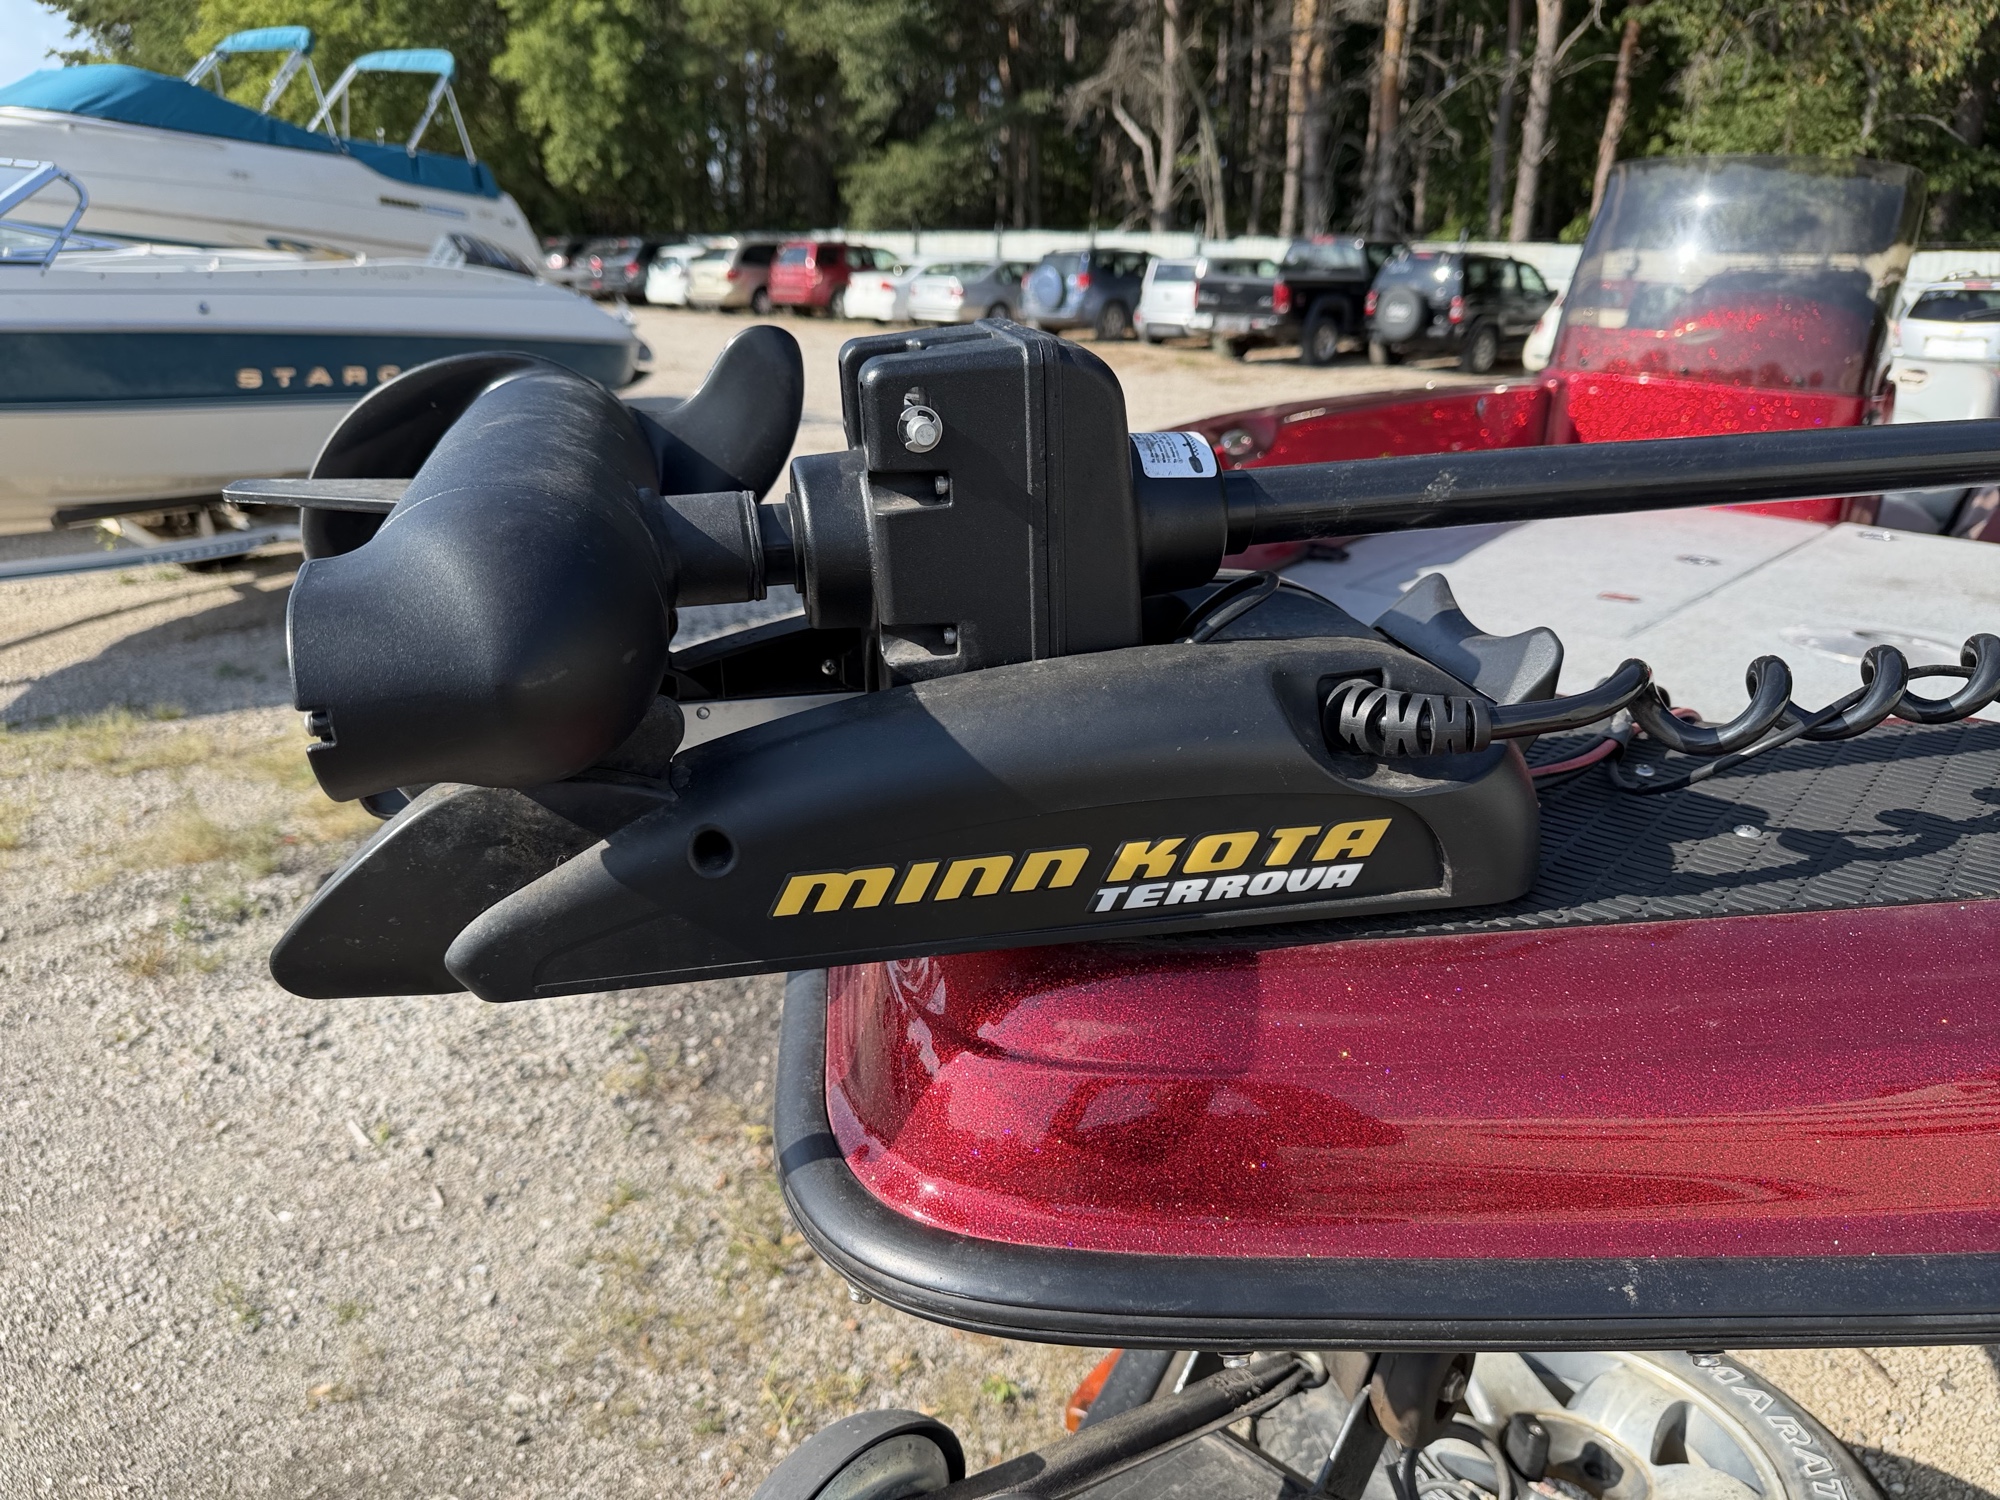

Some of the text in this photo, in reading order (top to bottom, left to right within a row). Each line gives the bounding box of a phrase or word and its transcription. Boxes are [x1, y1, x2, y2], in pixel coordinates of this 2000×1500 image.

[773, 818, 1392, 917] MINN KOTA
[1095, 863, 1363, 913] TERROVA
